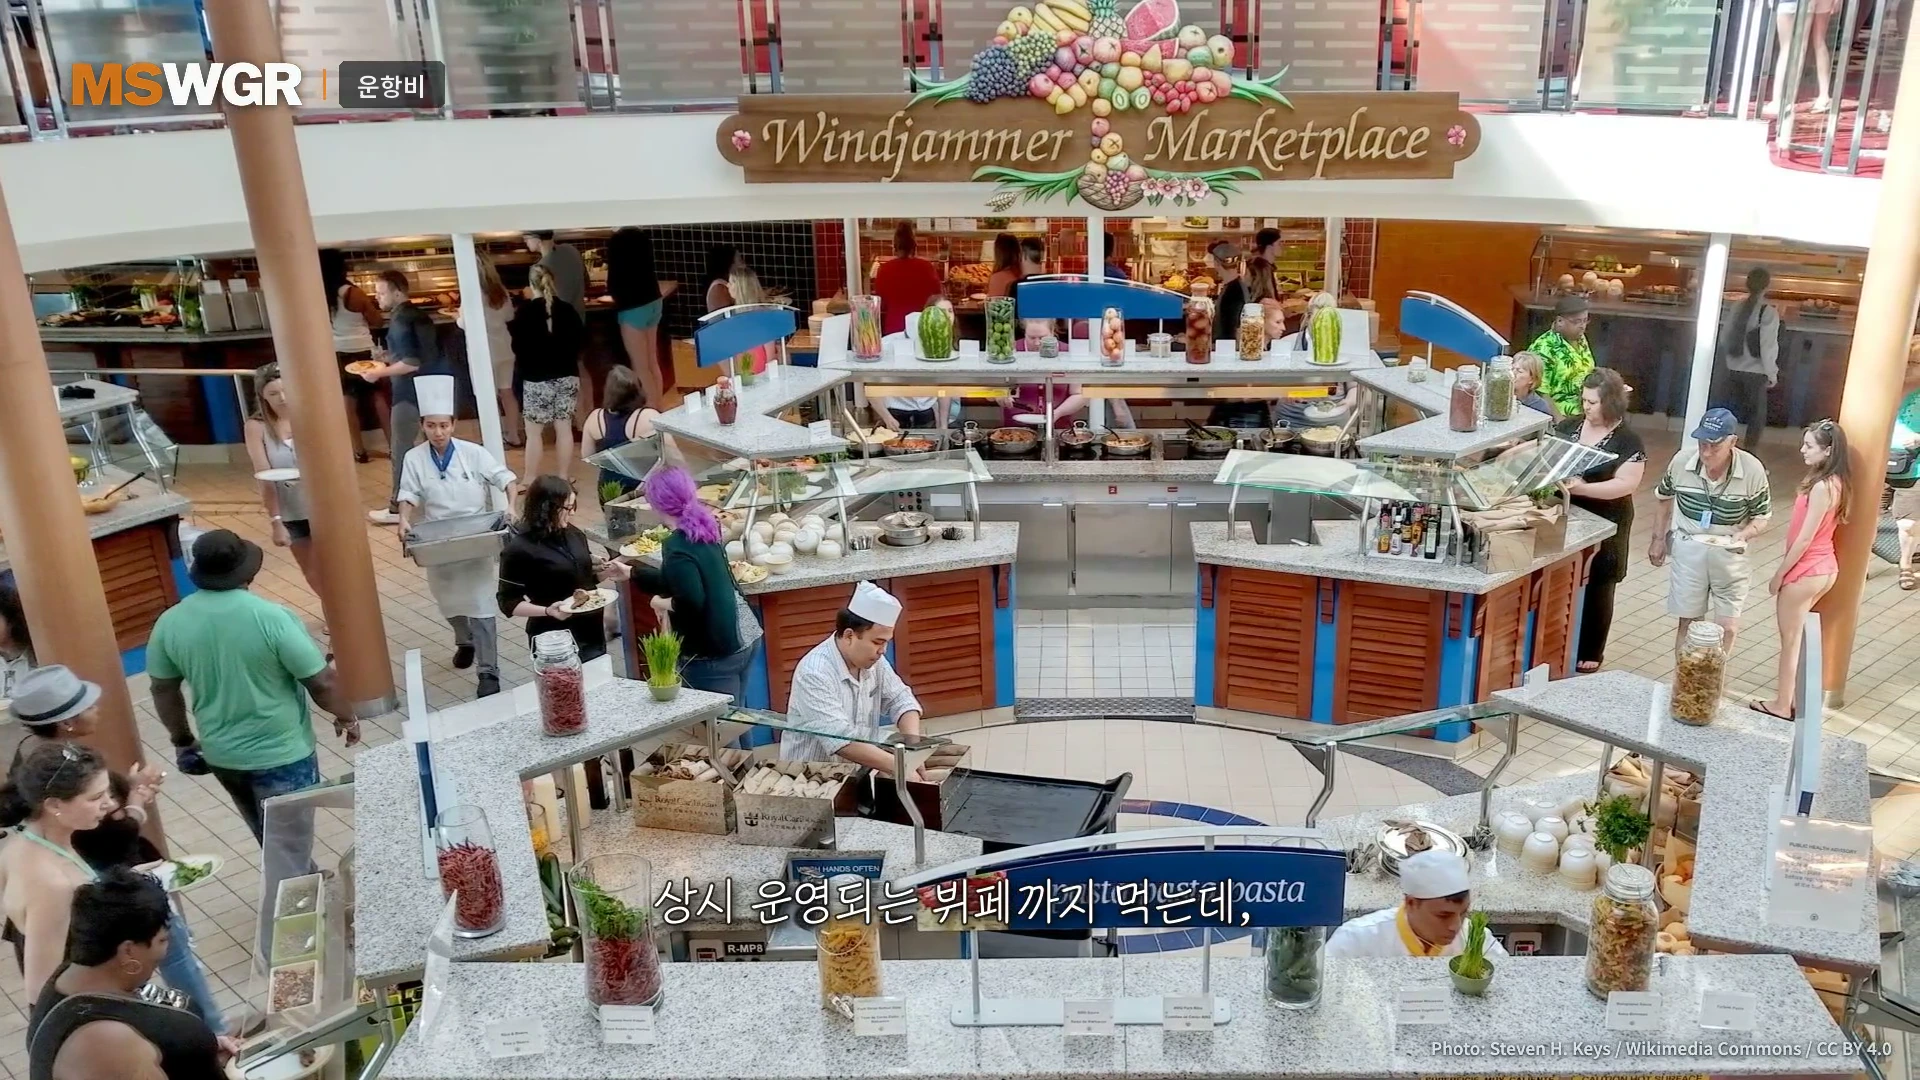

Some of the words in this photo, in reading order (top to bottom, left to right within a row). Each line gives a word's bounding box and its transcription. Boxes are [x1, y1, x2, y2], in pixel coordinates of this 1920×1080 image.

[762, 110, 1075, 184] Windjammer
[1145, 106, 1432, 181] Marketplace
[796, 866, 821, 874] WH
[823, 865, 852, 873] HANDS
[1229, 879, 1306, 905] pasta
[727, 944, 764, 954] R-MP8
